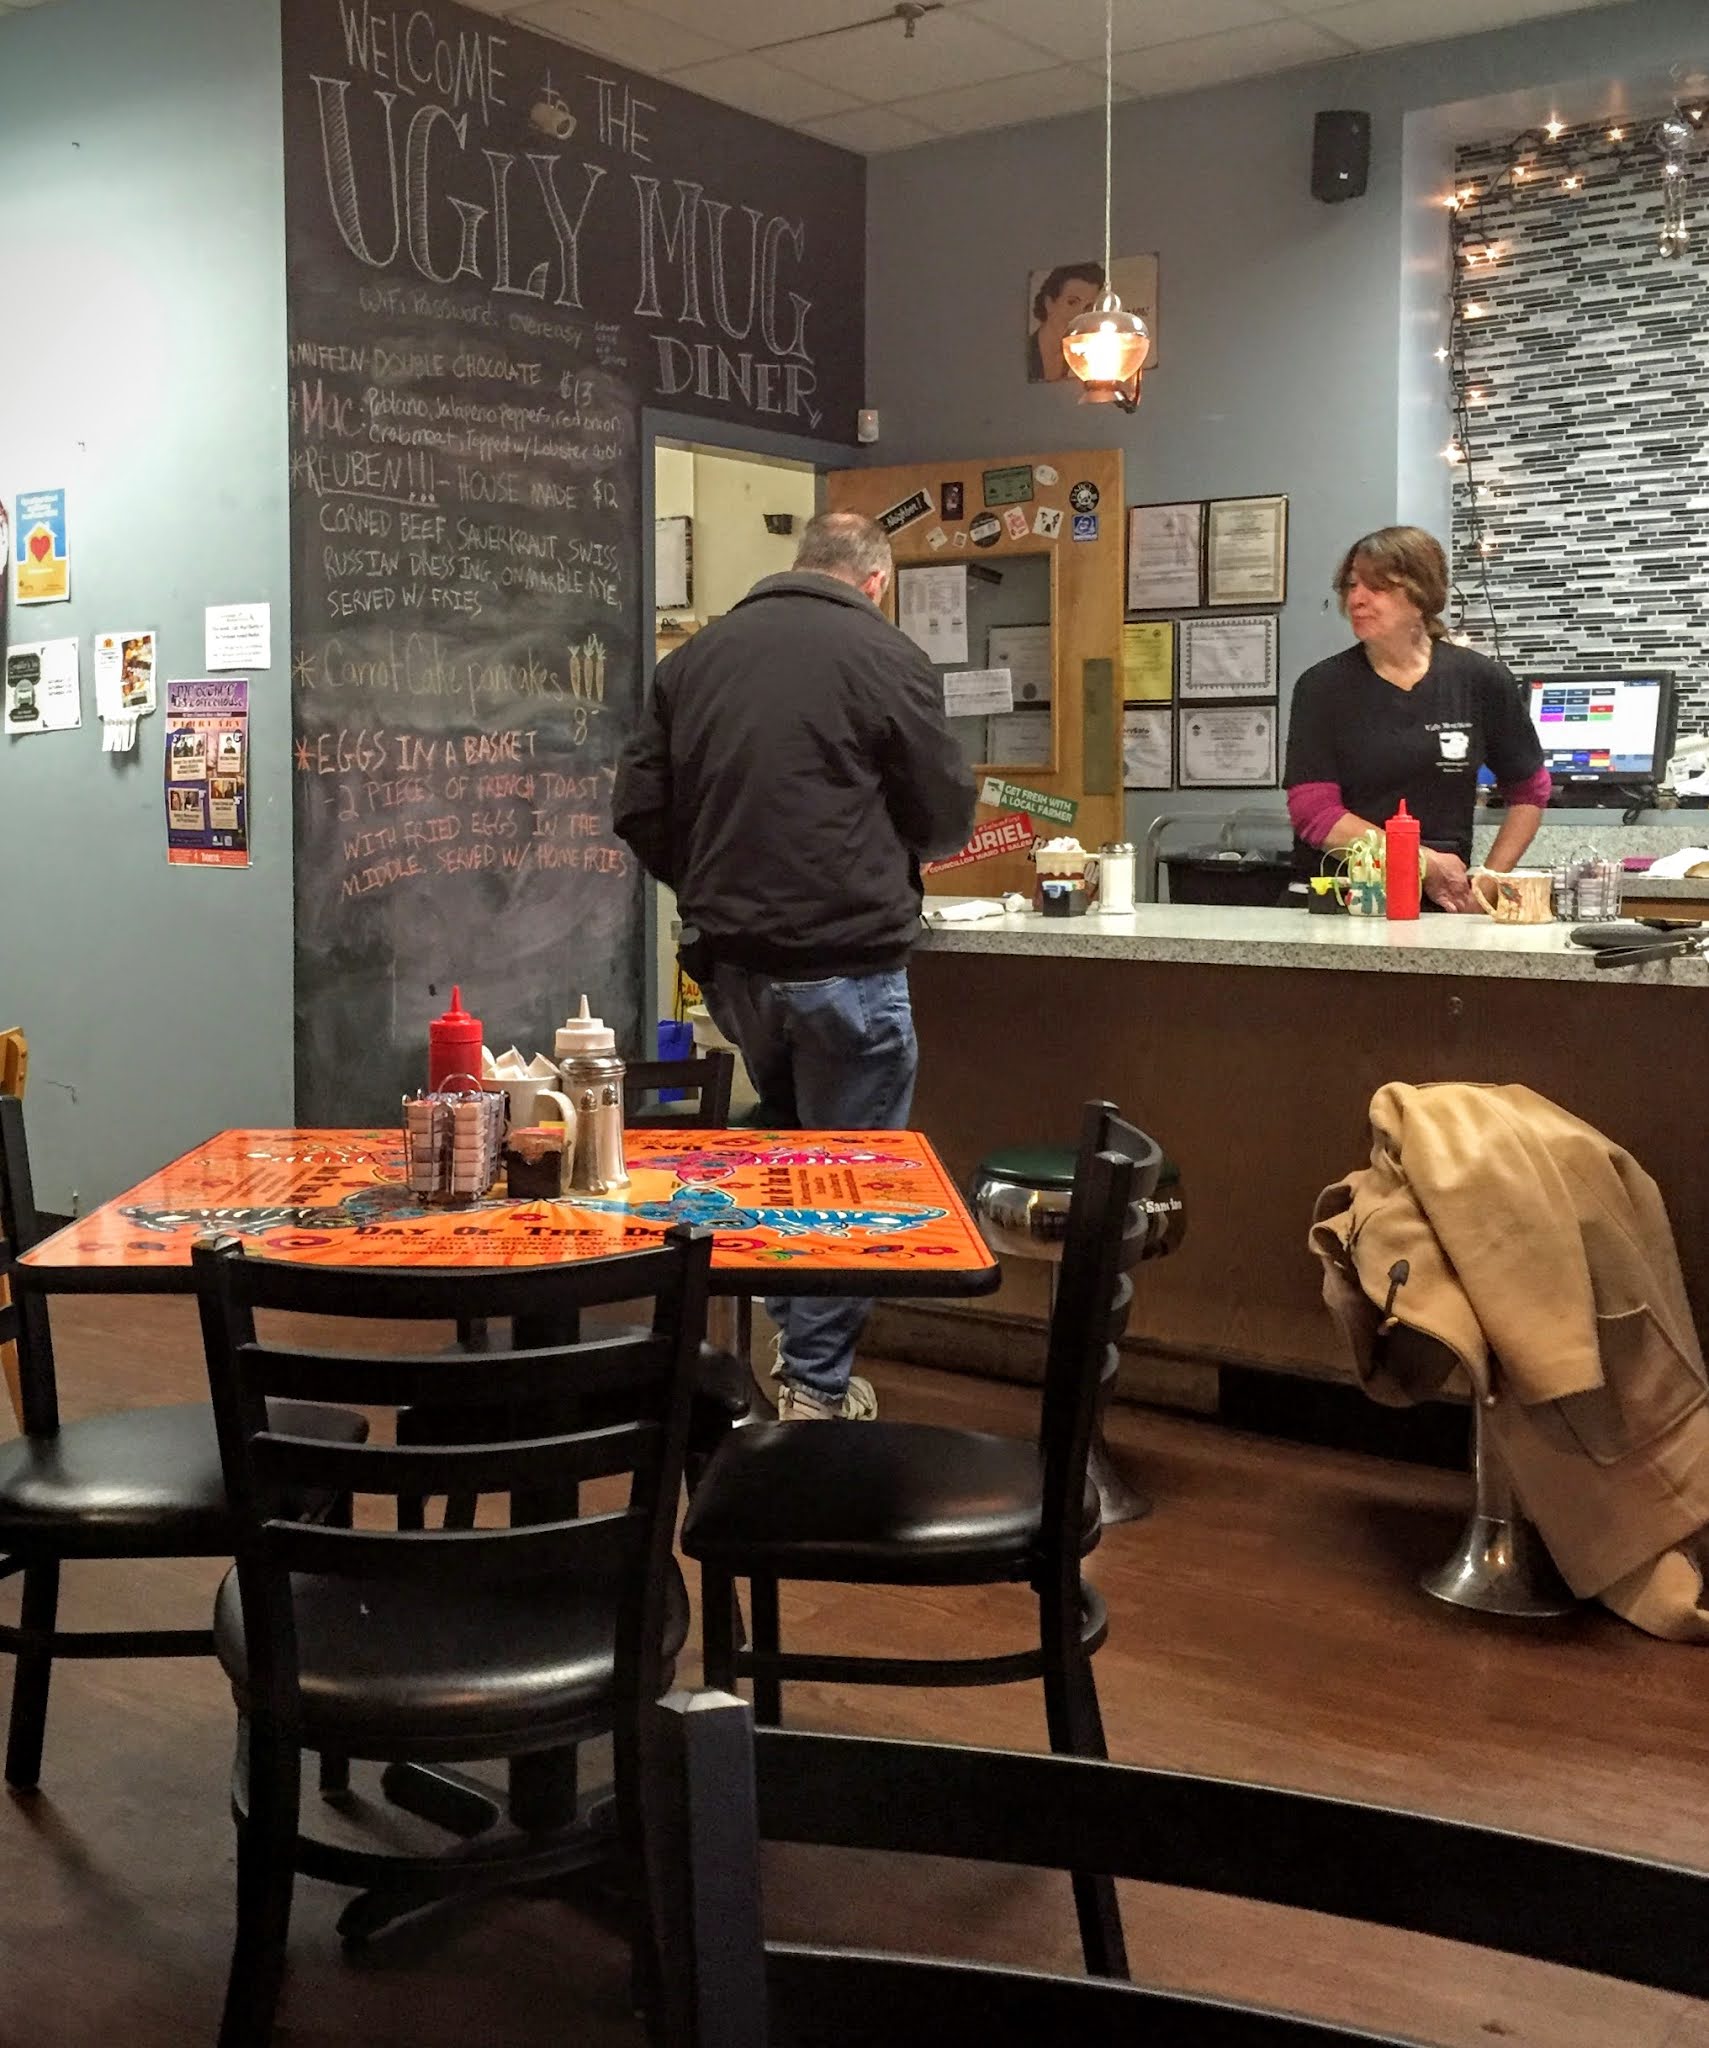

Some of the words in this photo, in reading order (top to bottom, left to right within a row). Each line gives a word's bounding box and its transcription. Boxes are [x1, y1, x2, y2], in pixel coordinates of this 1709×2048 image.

[339, 0, 507, 126] WELCOME
[585, 75, 657, 162] THE
[310, 74, 607, 309] UGLY
[631, 174, 815, 364] MUG
[650, 335, 823, 429] DINER
[458, 465, 518, 503] HOUSE
[531, 482, 577, 510] MADE
[320, 503, 393, 538] CORNED
[324, 545, 399, 582] RUSSIAN
[502, 566, 524, 587] ON
[525, 567, 583, 594] MARBLE
[327, 587, 396, 618] SERVED
[431, 587, 482, 620] FRIES
[324, 630, 403, 693] Carrot
[406, 632, 462, 695] Cake
[467, 647, 564, 717] pancakes
[318, 729, 387, 775] EGGS
[395, 734, 437, 772] IN
[445, 740, 458, 768] A
[463, 730, 537, 766] BASKET
[446, 776, 469, 800] OF
[478, 774, 535, 802] FRENCH
[540, 772, 599, 800] TOAST
[1005, 785, 1021, 796] GET
[1022, 790, 1048, 804] FRESH
[1049, 798, 1072, 811] WITH
[1001, 795, 1009, 804] A
[1009, 797, 1036, 813] LOCAL
[1037, 804, 1073, 823] FARMER
[344, 825, 398, 861] WITH
[403, 815, 461, 850] FRIED
[471, 808, 518, 838] EGGS
[531, 809, 558, 837] IN
[568, 813, 600, 839] THE
[960, 821, 1032, 857] URIEL
[976, 849, 999, 861] WARD
[1007, 838, 1033, 852] SALEM
[437, 844, 496, 875] SERVED
[537, 842, 580, 870] HOME
[354, 1226, 435, 1235] DAY
[453, 1226, 504, 1236] OF
[524, 1226, 603, 1236] THE
